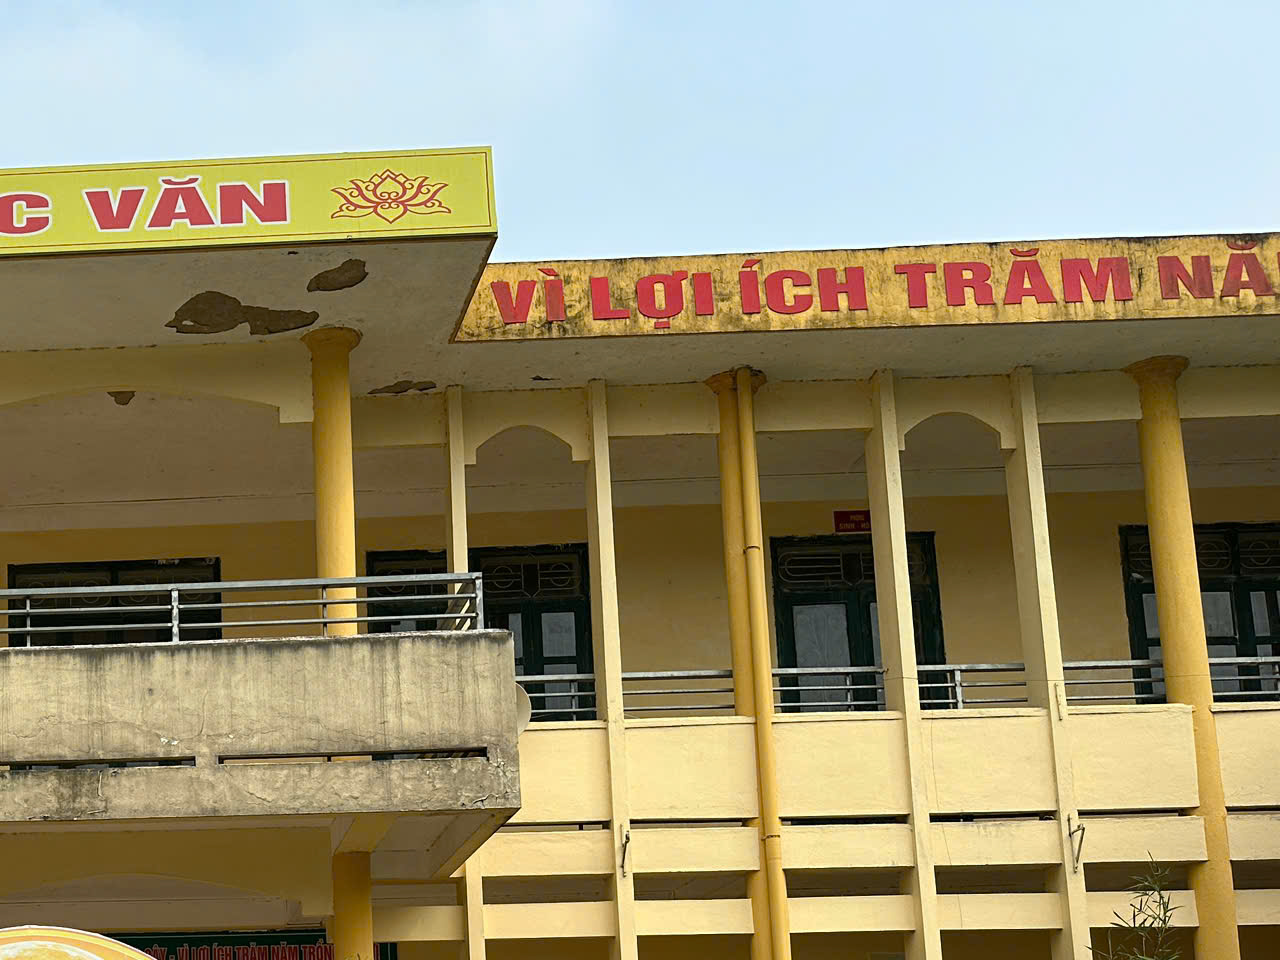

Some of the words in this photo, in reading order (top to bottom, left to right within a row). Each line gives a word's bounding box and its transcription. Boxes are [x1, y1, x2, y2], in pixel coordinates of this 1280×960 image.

[87, 178, 286, 229] VĂN
[491, 268, 566, 324] VÌ
[590, 270, 714, 328] LỢI
[739, 259, 868, 314] ÍCH
[894, 248, 1133, 308] TRĂM
[1158, 244, 1280, 298] NĂ
